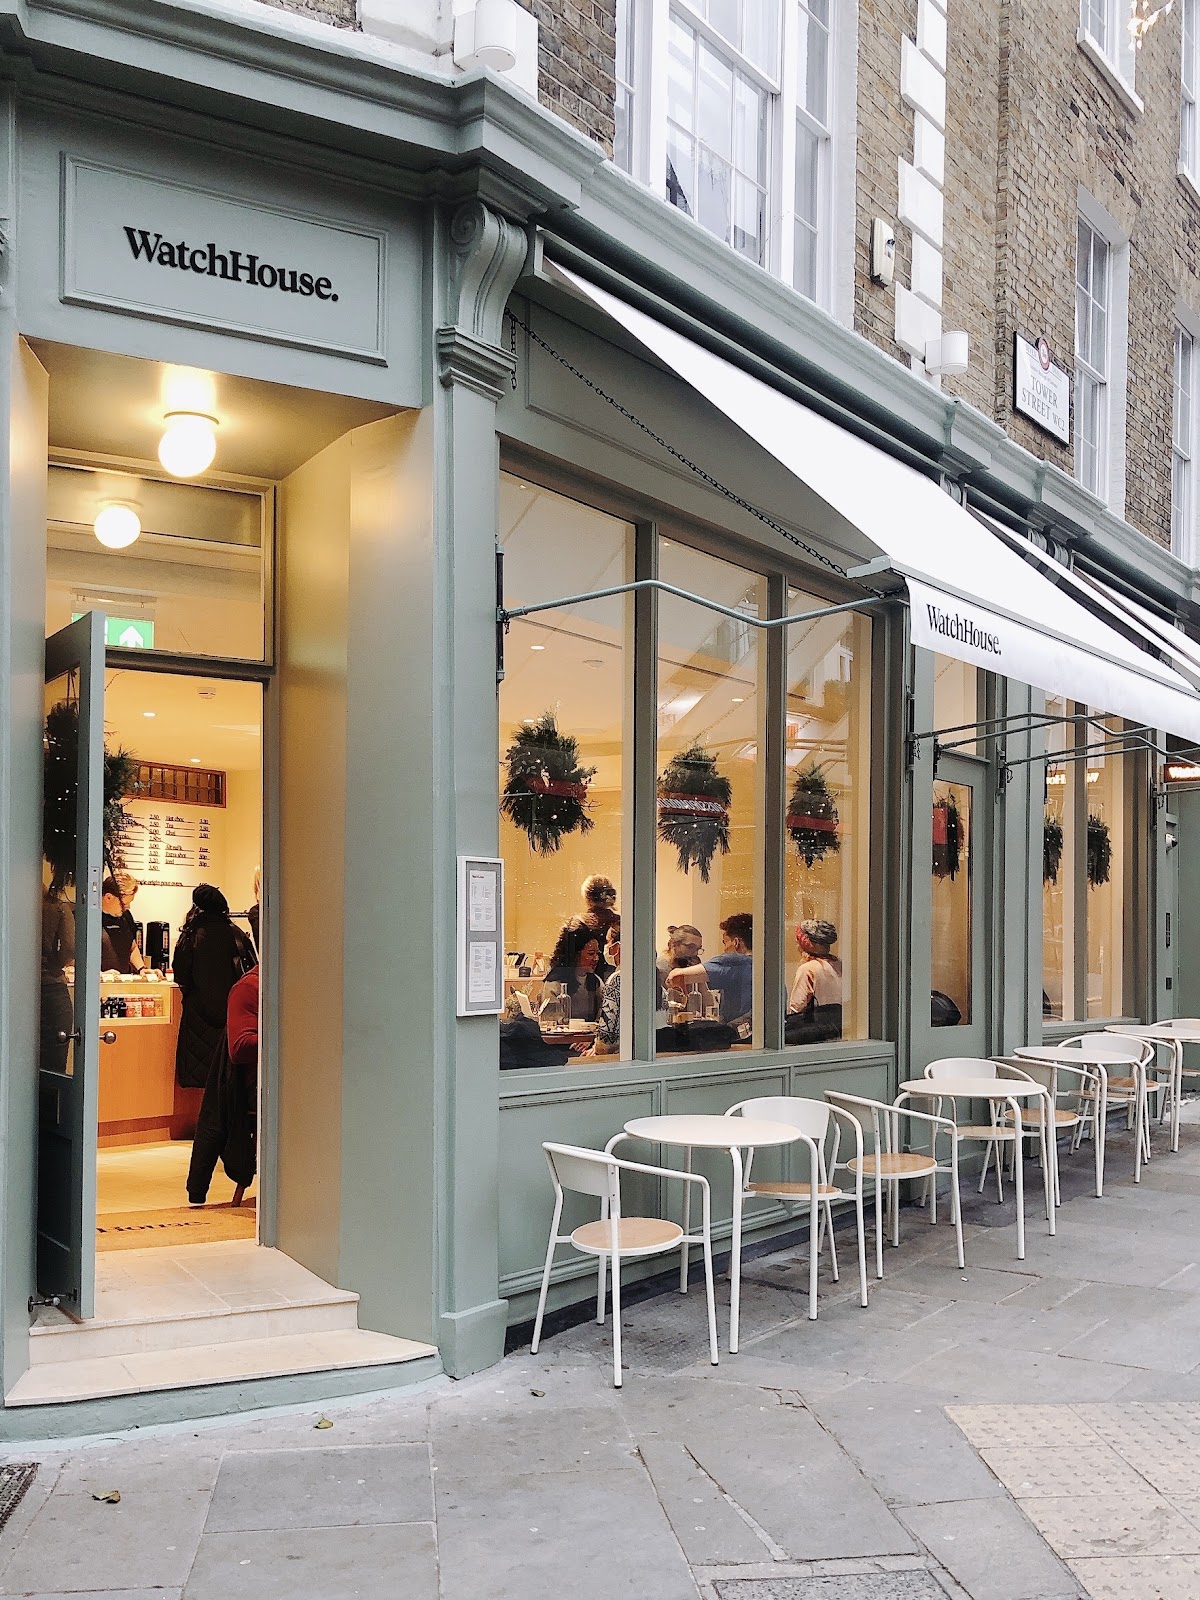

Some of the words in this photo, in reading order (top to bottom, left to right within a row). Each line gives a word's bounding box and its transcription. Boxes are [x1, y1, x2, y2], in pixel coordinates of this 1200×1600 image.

[123, 226, 339, 302] WatchHouse.
[1022, 387, 1051, 420] STREET
[1031, 375, 1058, 409] TOWER
[926, 603, 1002, 656] WatchHouse.
